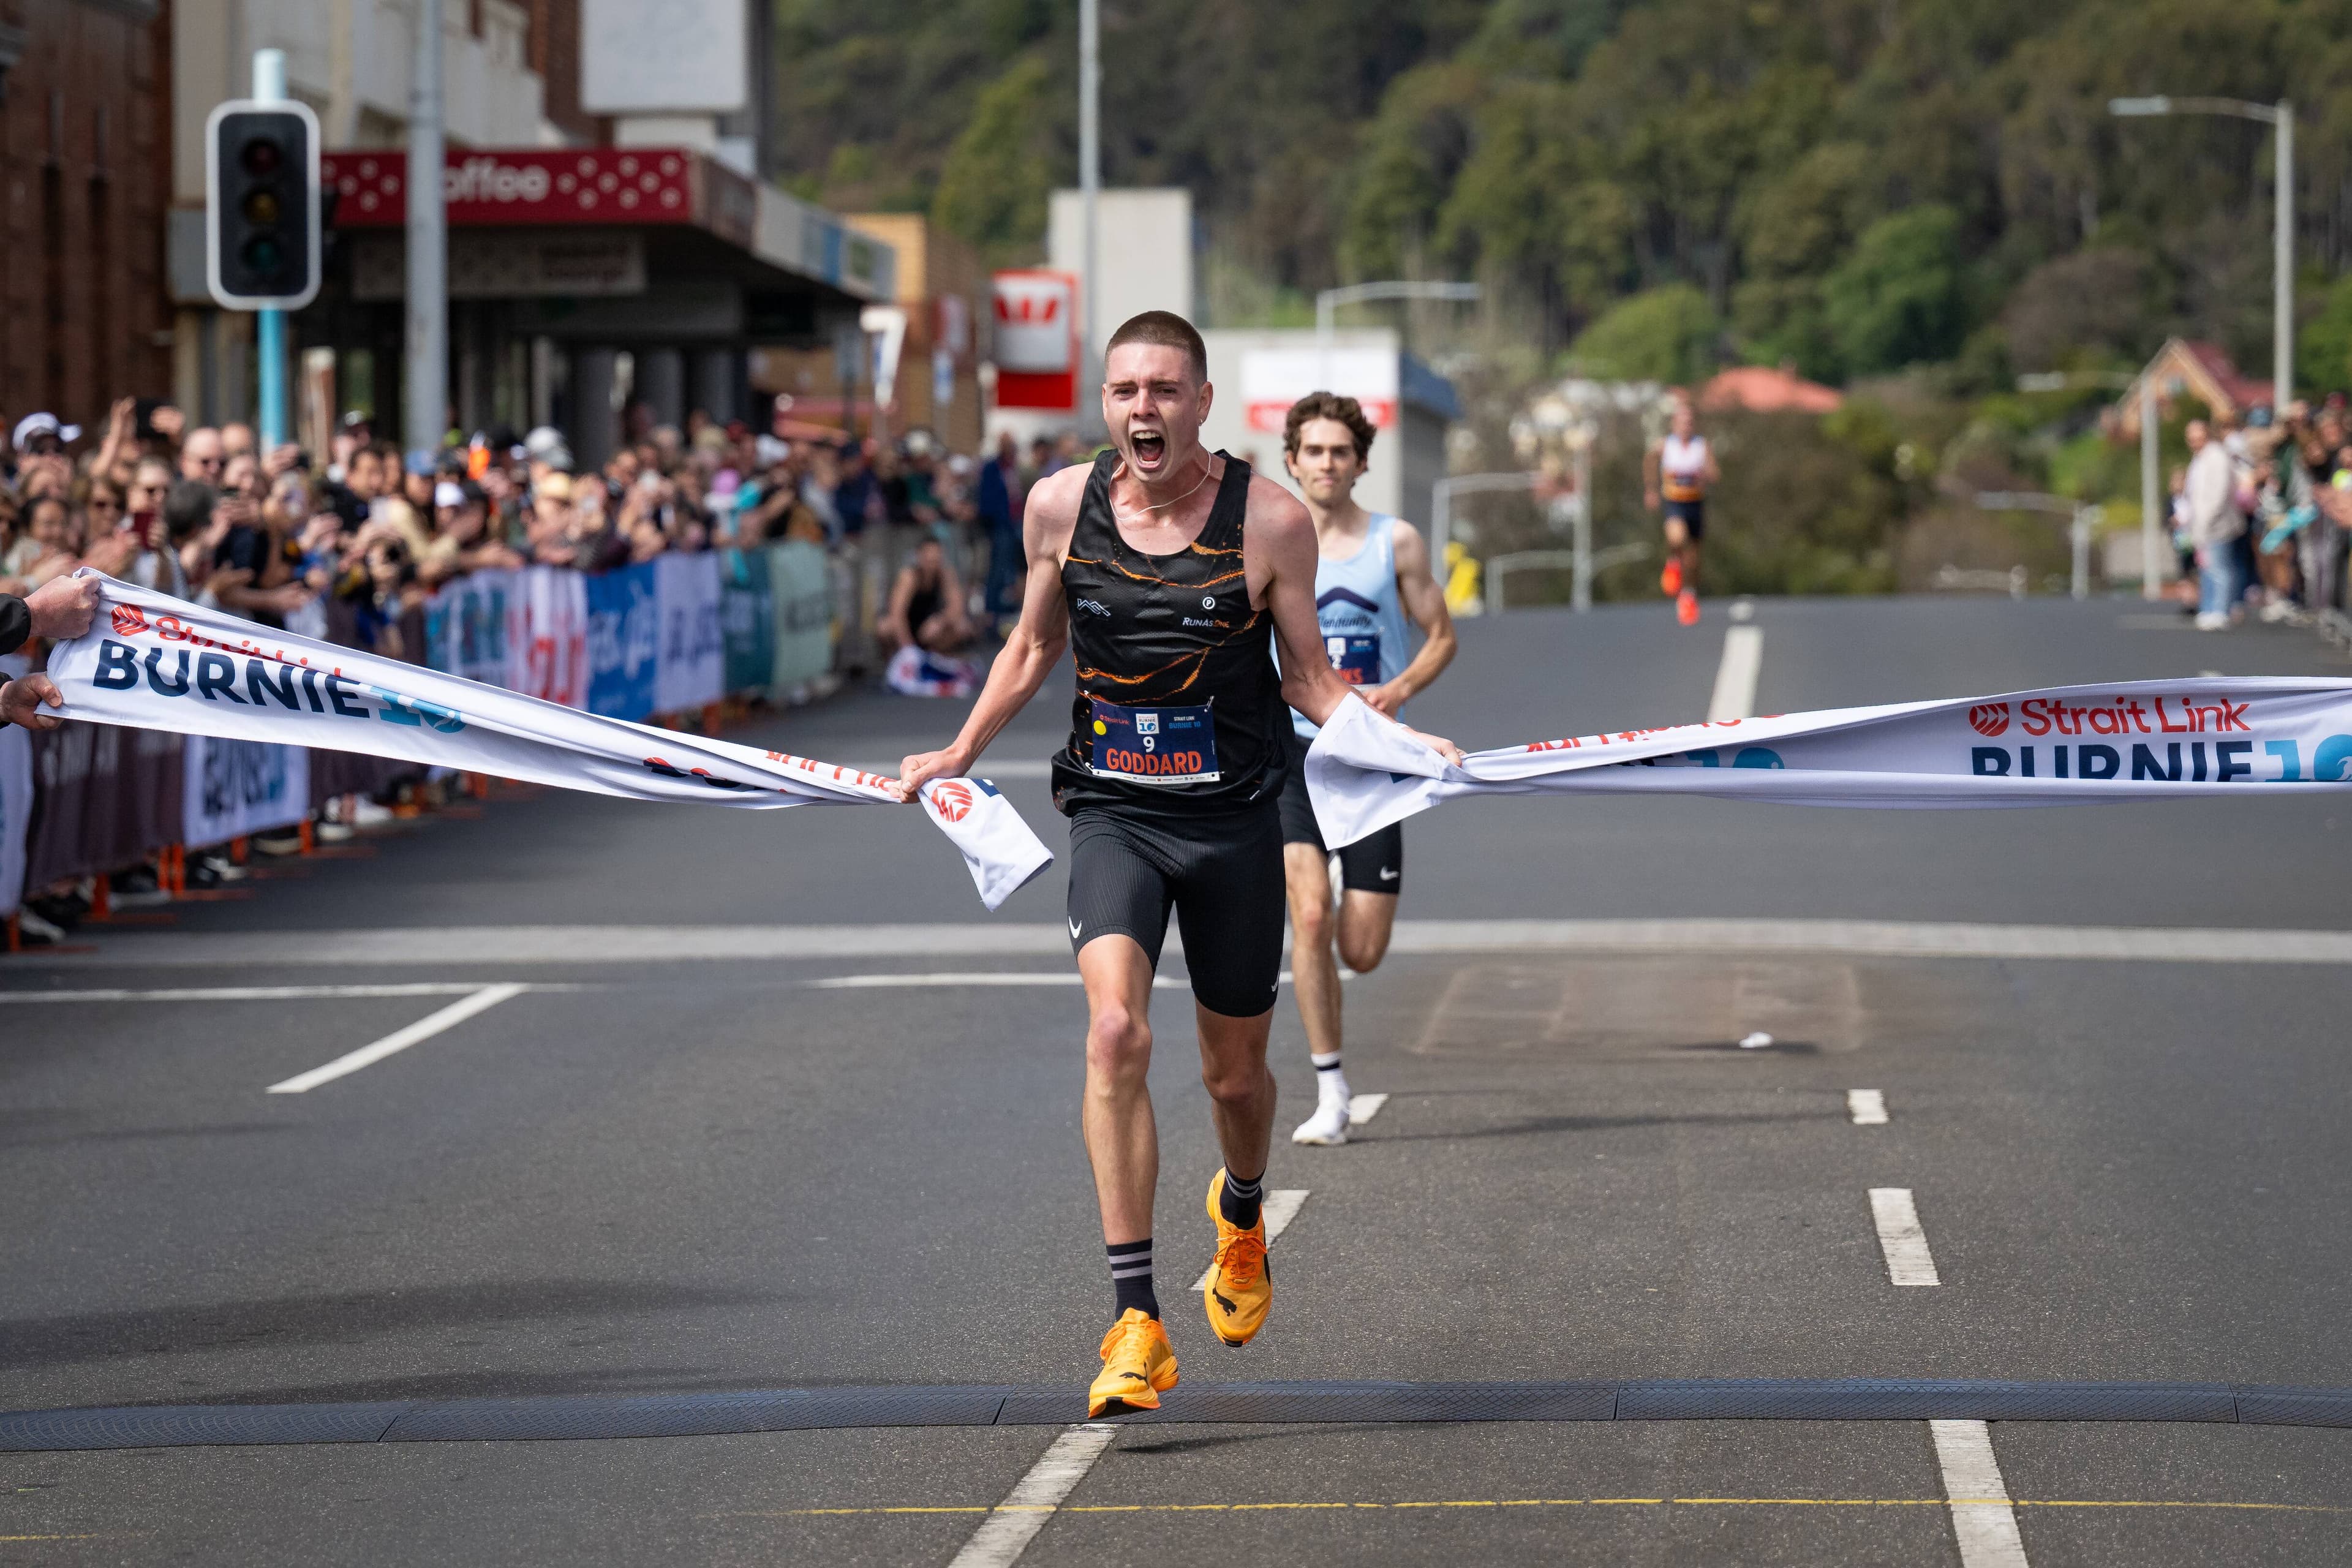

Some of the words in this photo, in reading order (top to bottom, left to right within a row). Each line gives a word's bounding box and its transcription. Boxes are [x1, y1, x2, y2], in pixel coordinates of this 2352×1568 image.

[445, 156, 549, 203] offee
[2022, 696, 2151, 736] Strait
[2155, 697, 2252, 733] Link
[1143, 736, 1155, 753] 9
[1106, 748, 1202, 775] GODDARD
